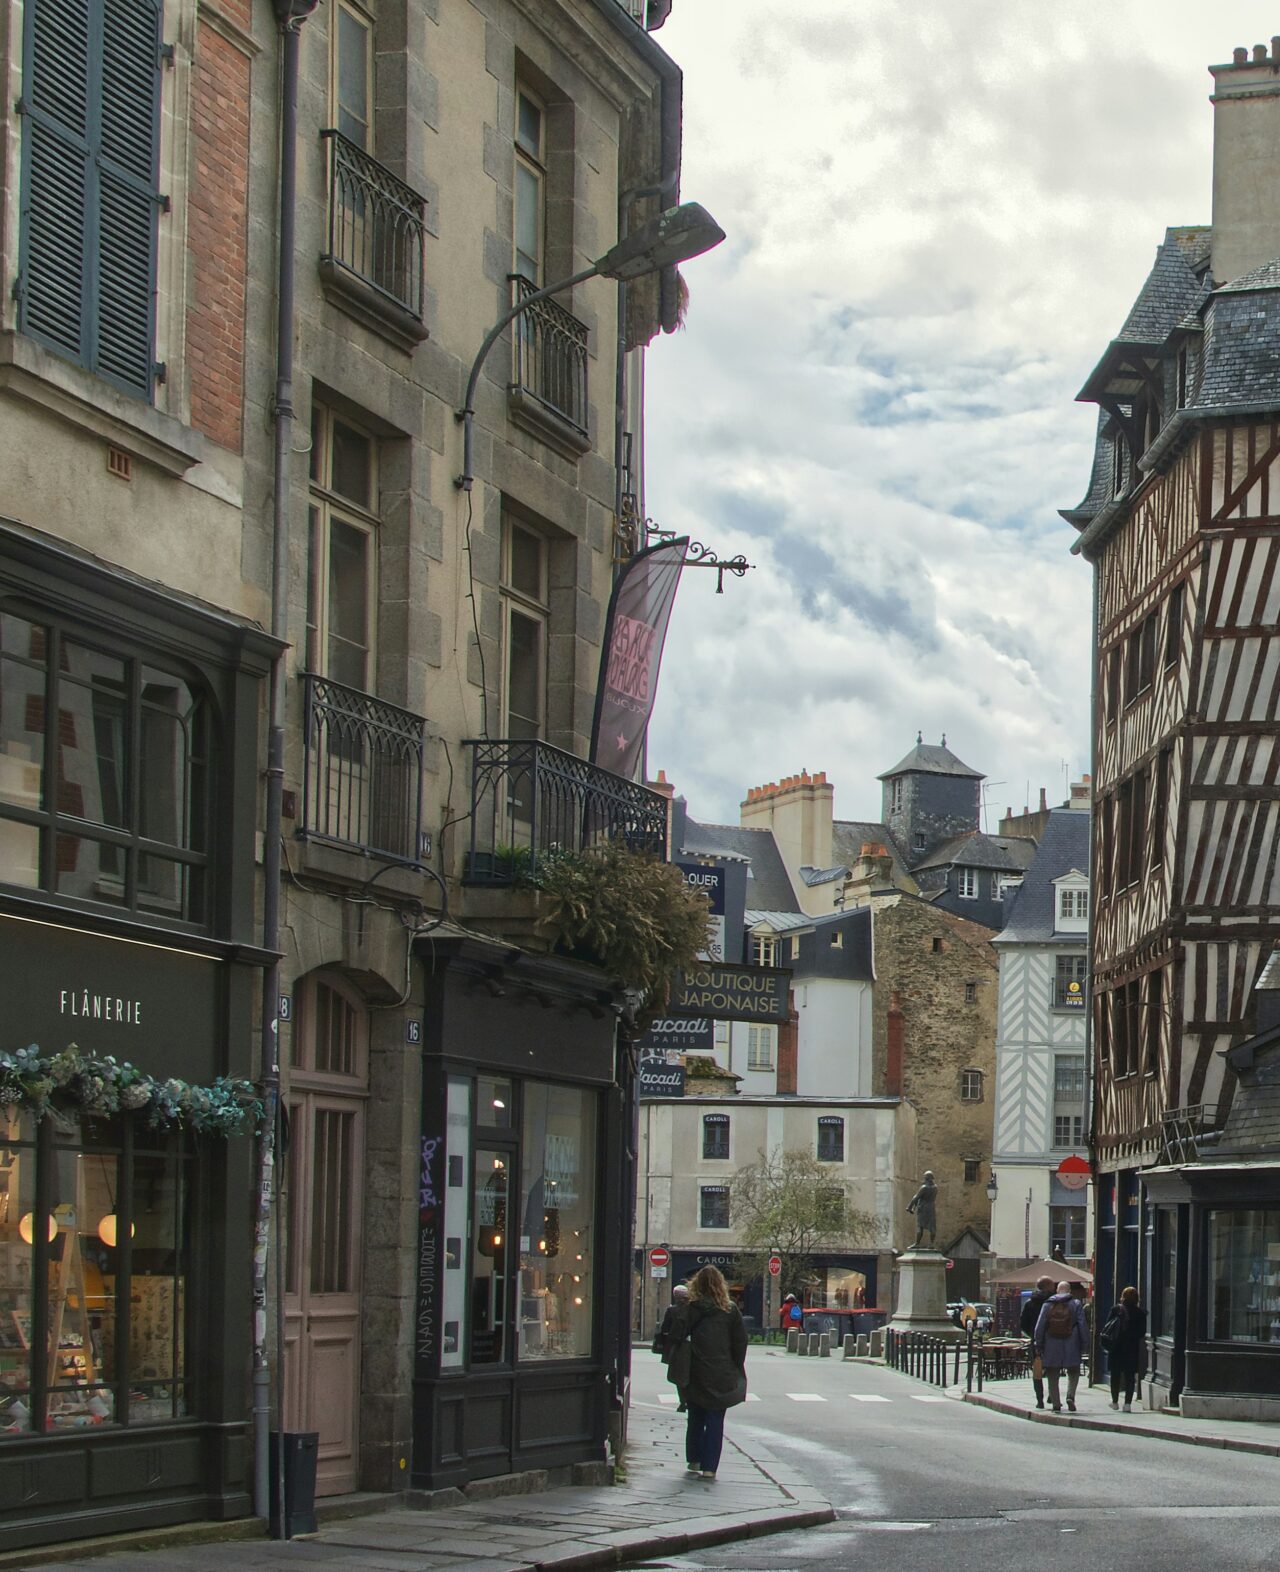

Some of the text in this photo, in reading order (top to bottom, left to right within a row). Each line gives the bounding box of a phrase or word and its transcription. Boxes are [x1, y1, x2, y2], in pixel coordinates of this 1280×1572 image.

[684, 971, 776, 993] BOUTIQUE
[60, 988, 141, 1024] FLÂNERIE
[280, 997, 288, 1018] 8
[680, 990, 779, 1014] JAPONAISE
[409, 1021, 419, 1040] 16
[651, 1018, 709, 1034] acadi
[652, 1035, 696, 1044] PARIS
[643, 1085, 673, 1093] PARIS
[696, 1256, 737, 1264] CAROLL
